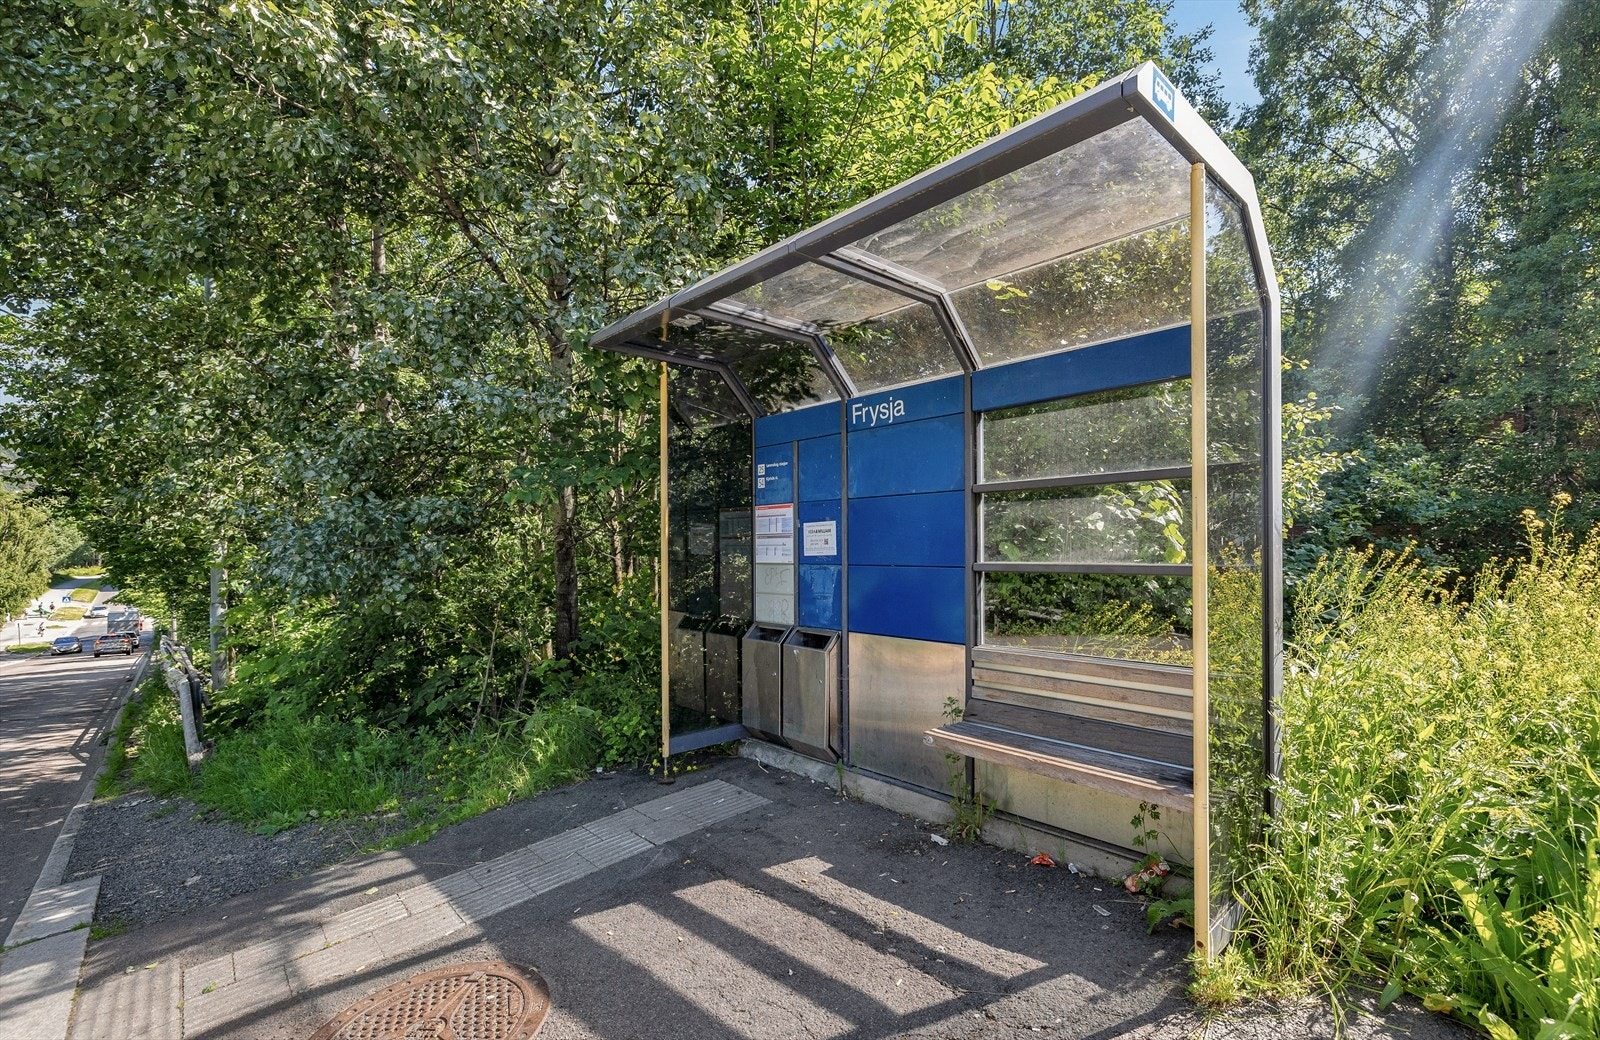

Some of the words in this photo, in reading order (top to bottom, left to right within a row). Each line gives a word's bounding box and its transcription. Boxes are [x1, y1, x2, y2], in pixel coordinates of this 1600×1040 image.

[852, 396, 906, 427] Frysja
[758, 465, 765, 475] 25
[758, 478, 765, 488] 54
